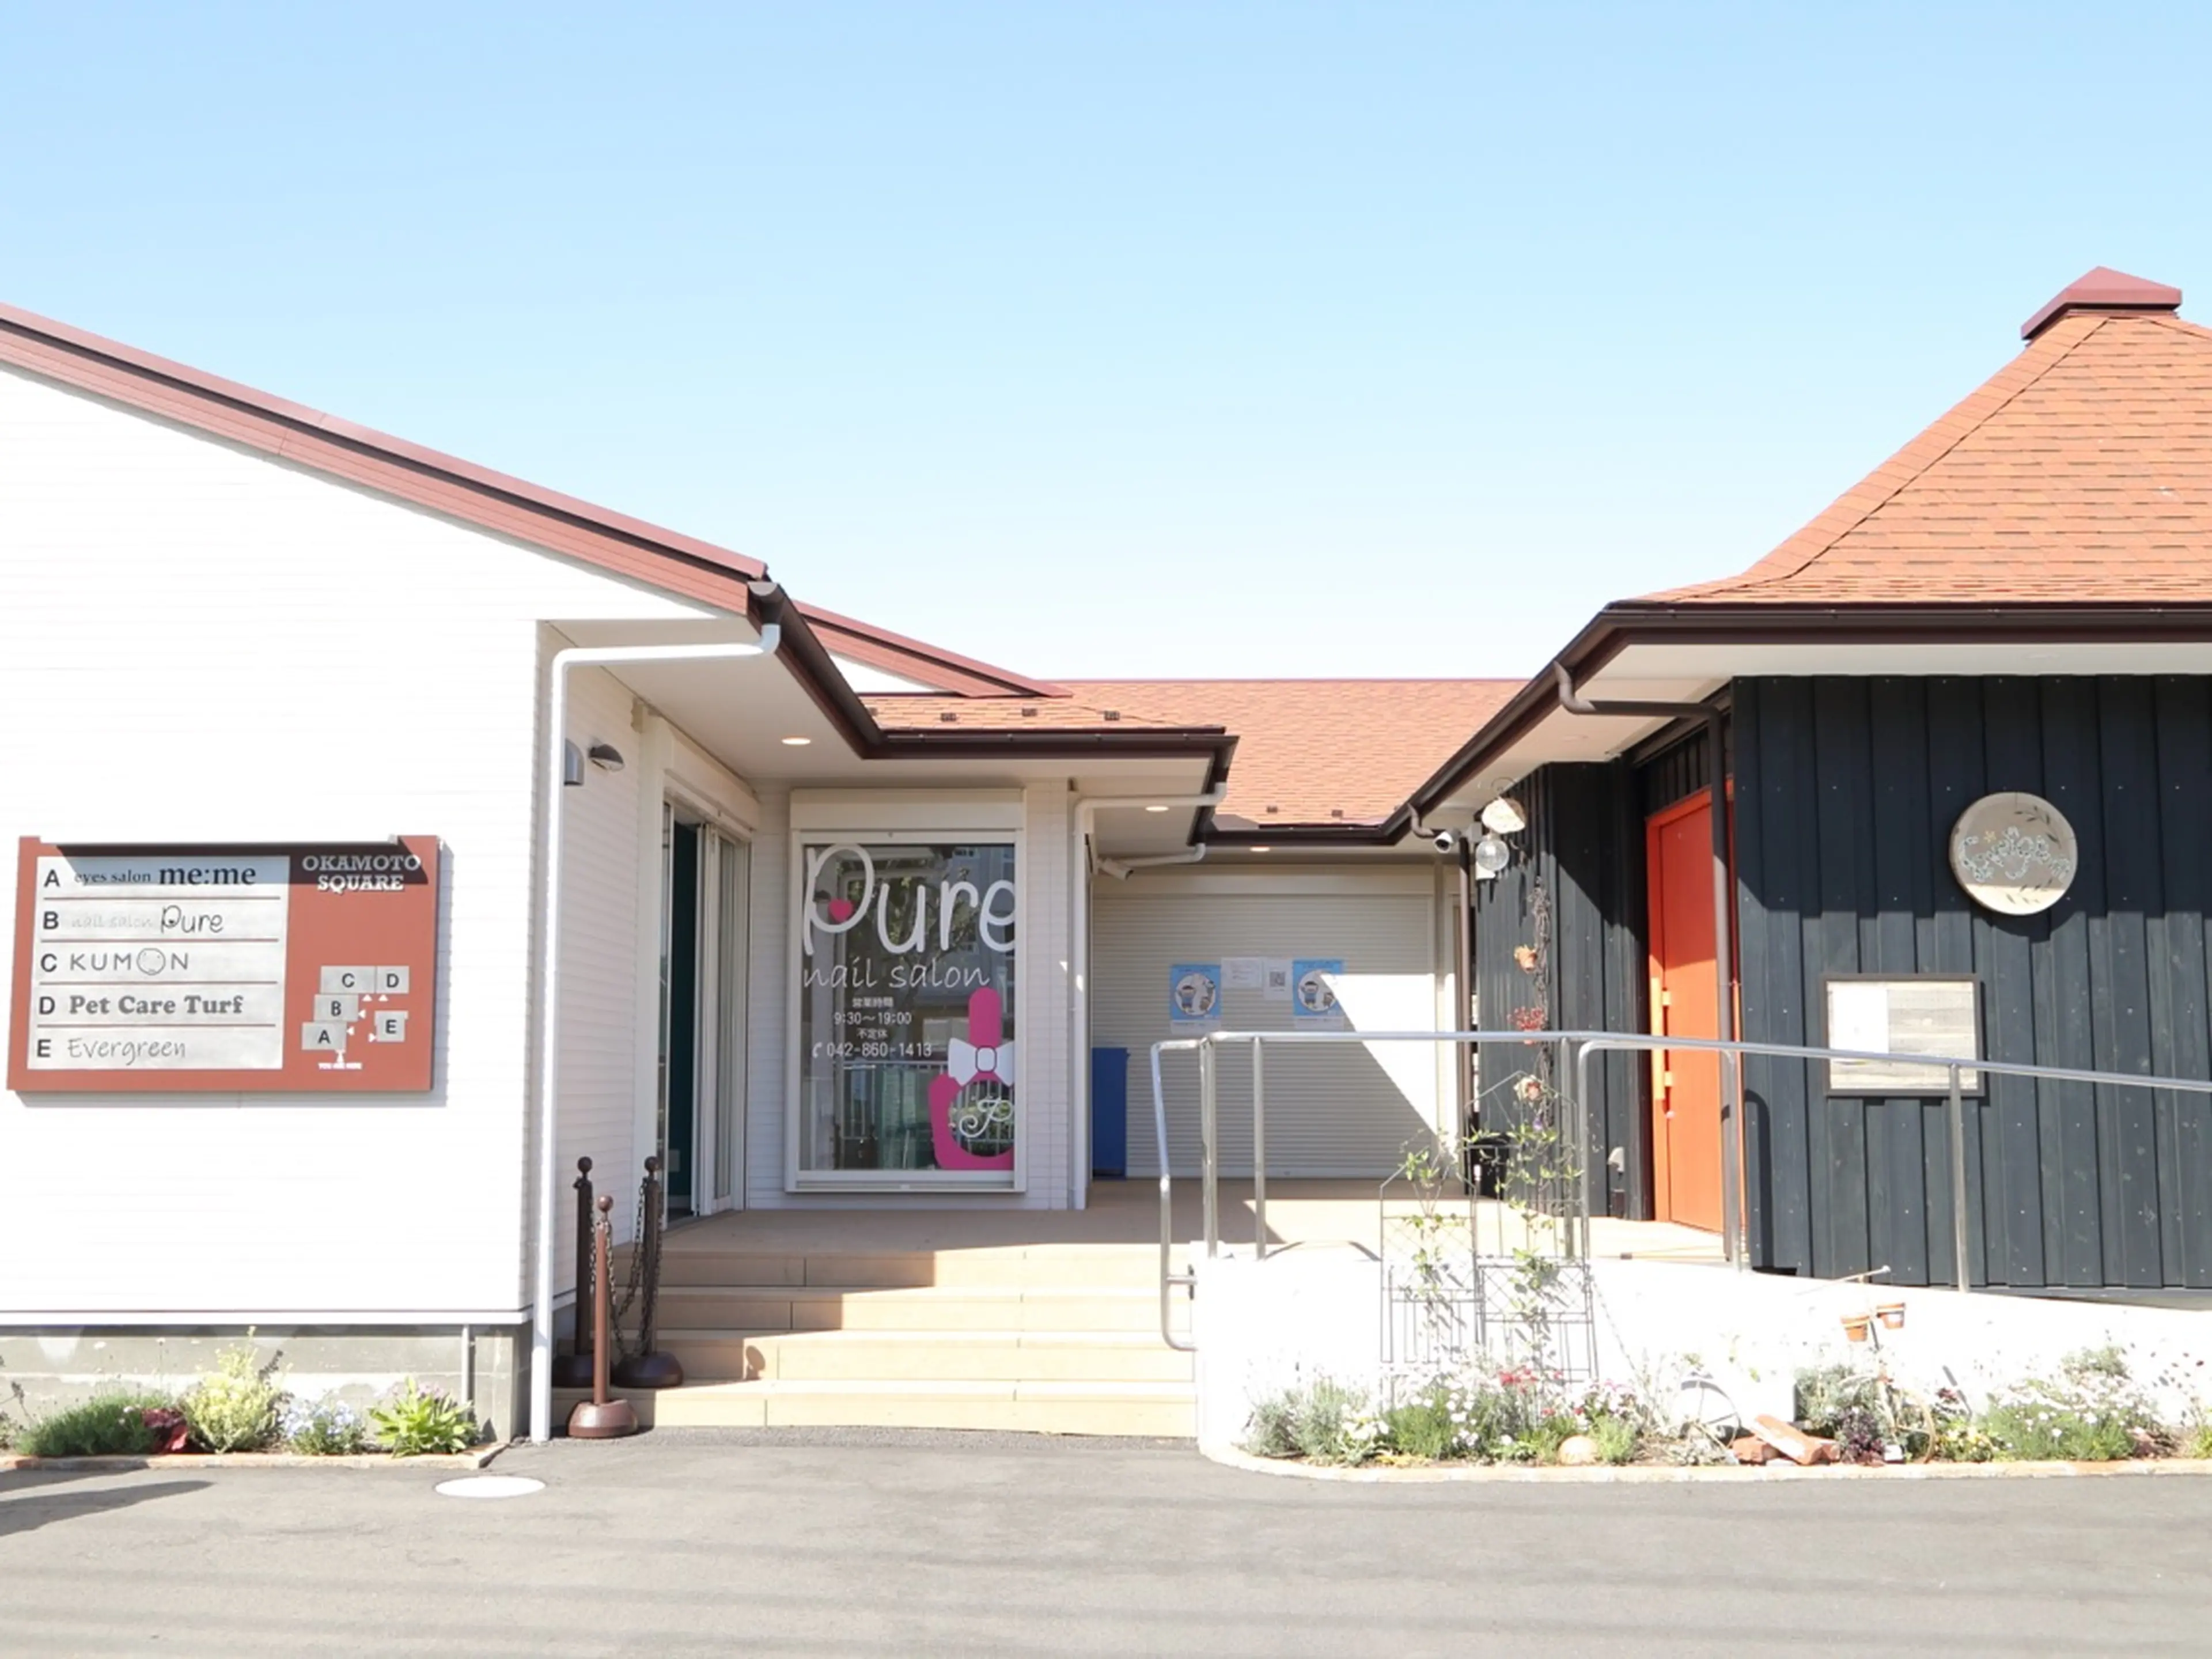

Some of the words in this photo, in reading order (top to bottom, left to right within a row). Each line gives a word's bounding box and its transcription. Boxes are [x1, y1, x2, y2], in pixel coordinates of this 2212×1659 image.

[302, 854, 422, 872] OKAMOTO
[43, 869, 59, 888] A
[74, 872, 107, 884] eyes
[111, 869, 151, 883] salon
[159, 866, 256, 885] me:me
[317, 874, 404, 893] SQUARE
[802, 843, 1014, 956] Pure
[43, 911, 59, 929] B
[160, 904, 224, 934] Pure
[40, 954, 57, 972] C
[70, 948, 188, 975] KUMON
[342, 973, 355, 988] C
[386, 974, 399, 988] D
[804, 957, 877, 988] nail
[889, 959, 990, 988] salon
[39, 996, 56, 1014] D
[69, 995, 111, 1014] Pet
[118, 995, 176, 1014] Care
[184, 995, 244, 1014] Turf
[331, 1001, 342, 1017] B
[385, 1019, 397, 1034] E
[857, 1028, 888, 1040] 不定休
[318, 1029, 331, 1044] A
[37, 1039, 52, 1058] E
[67, 1037, 186, 1066] Evergreen
